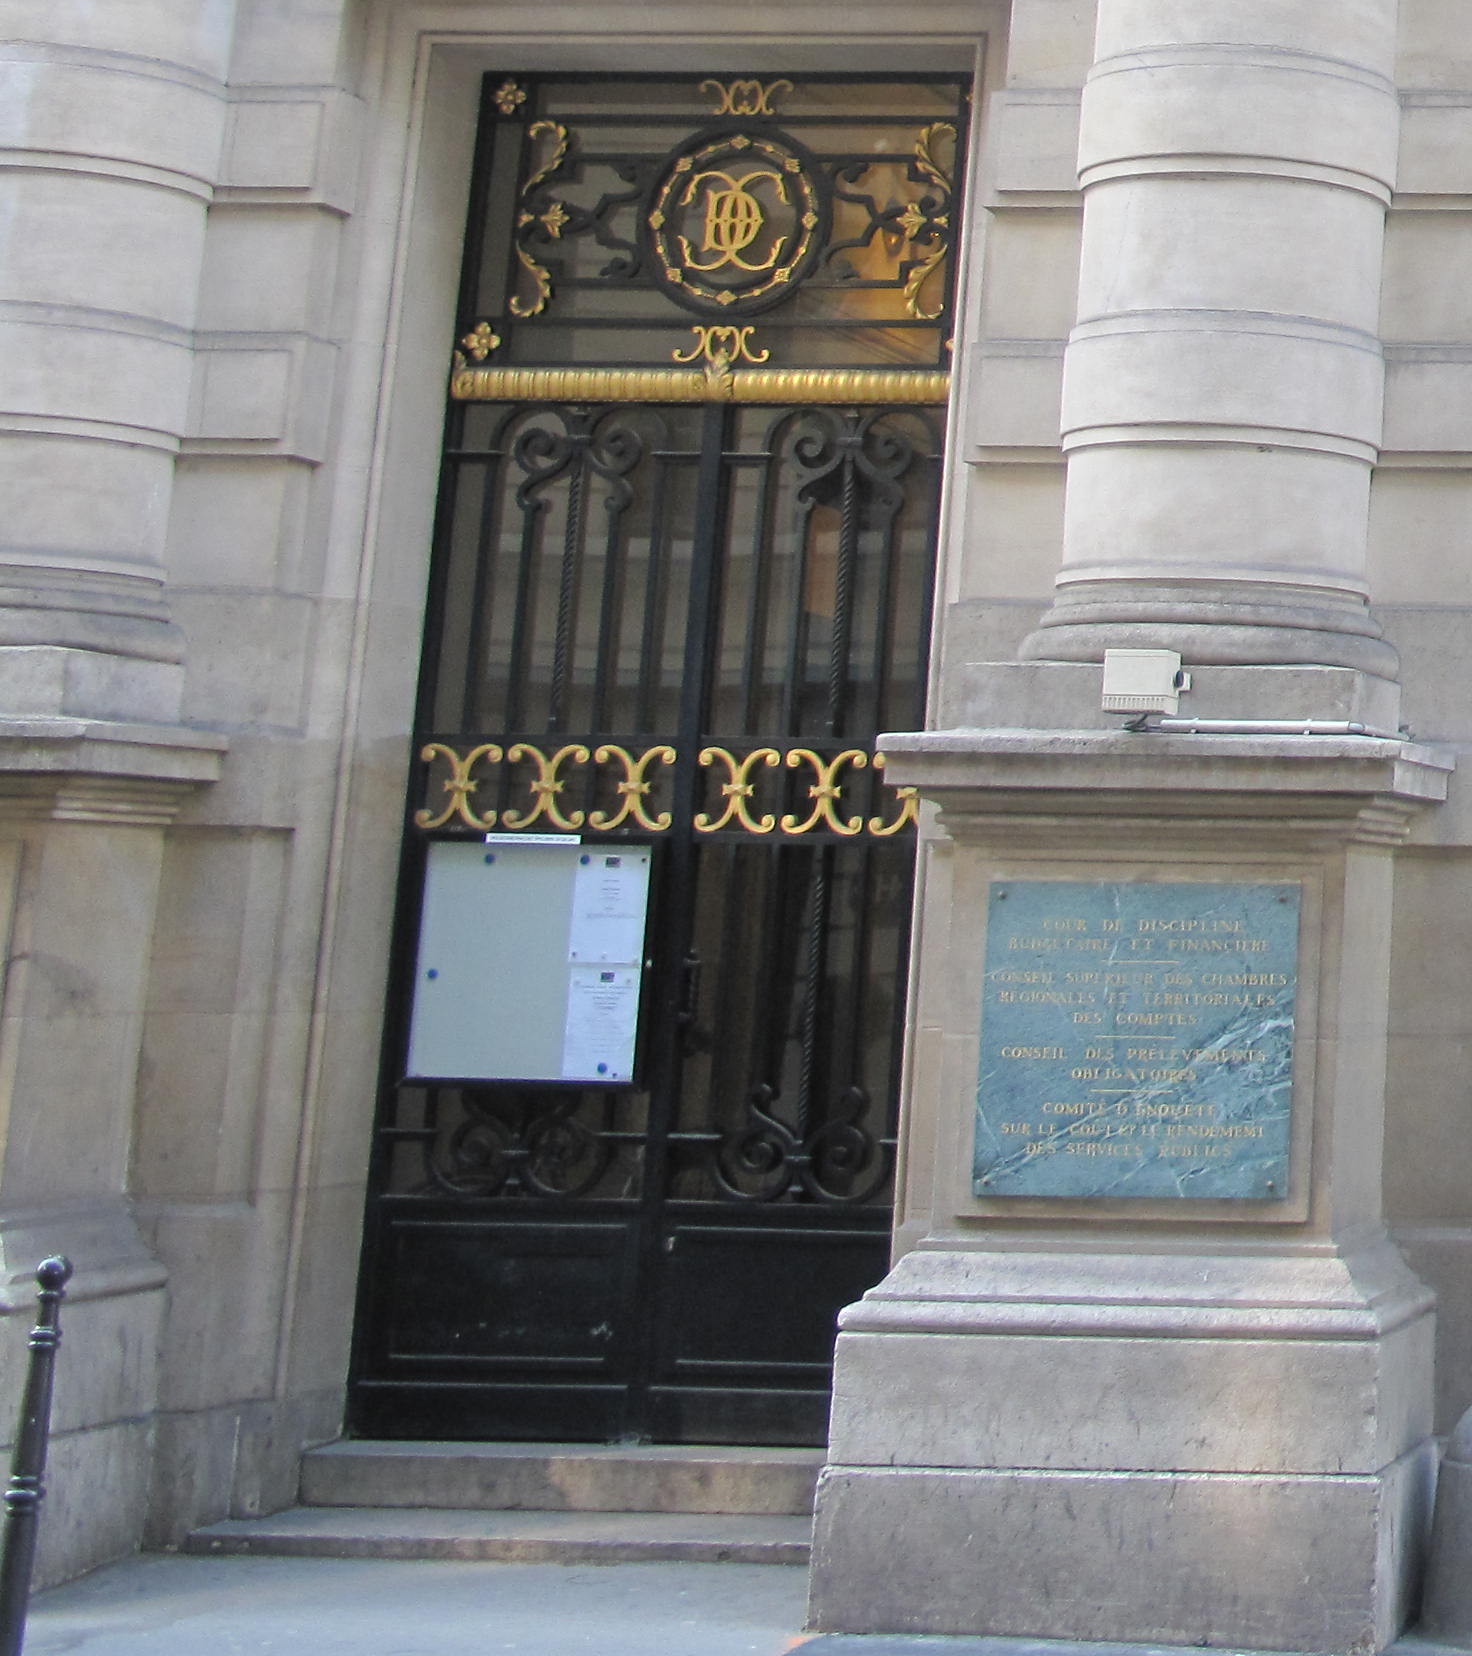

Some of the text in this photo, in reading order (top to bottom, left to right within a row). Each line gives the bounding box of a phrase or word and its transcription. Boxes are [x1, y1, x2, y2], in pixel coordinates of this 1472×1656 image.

[1043, 919, 1243, 933] COUR DE DISCIPLINE
[1131, 939, 1152, 951] ET
[991, 972, 1056, 985] CONSEIL
[1164, 973, 1194, 986] DES
[1202, 973, 1288, 987] CHAMBRES
[1108, 992, 1129, 1005] ET
[1072, 1012, 1198, 1026] DES COMPTES
[1001, 1046, 1068, 1060] CONSEIL
[1086, 1047, 1116, 1060] DES
[1072, 1067, 1197, 1082] OBLIGATOIRES
[1002, 1122, 1032, 1136] SUR
[1039, 1123, 1057, 1136] LE
[1142, 1124, 1160, 1137] LE
[1167, 1124, 1265, 1139] RENDEMENT
[1026, 1142, 1234, 1157] DES SERVICES PUBLICS
